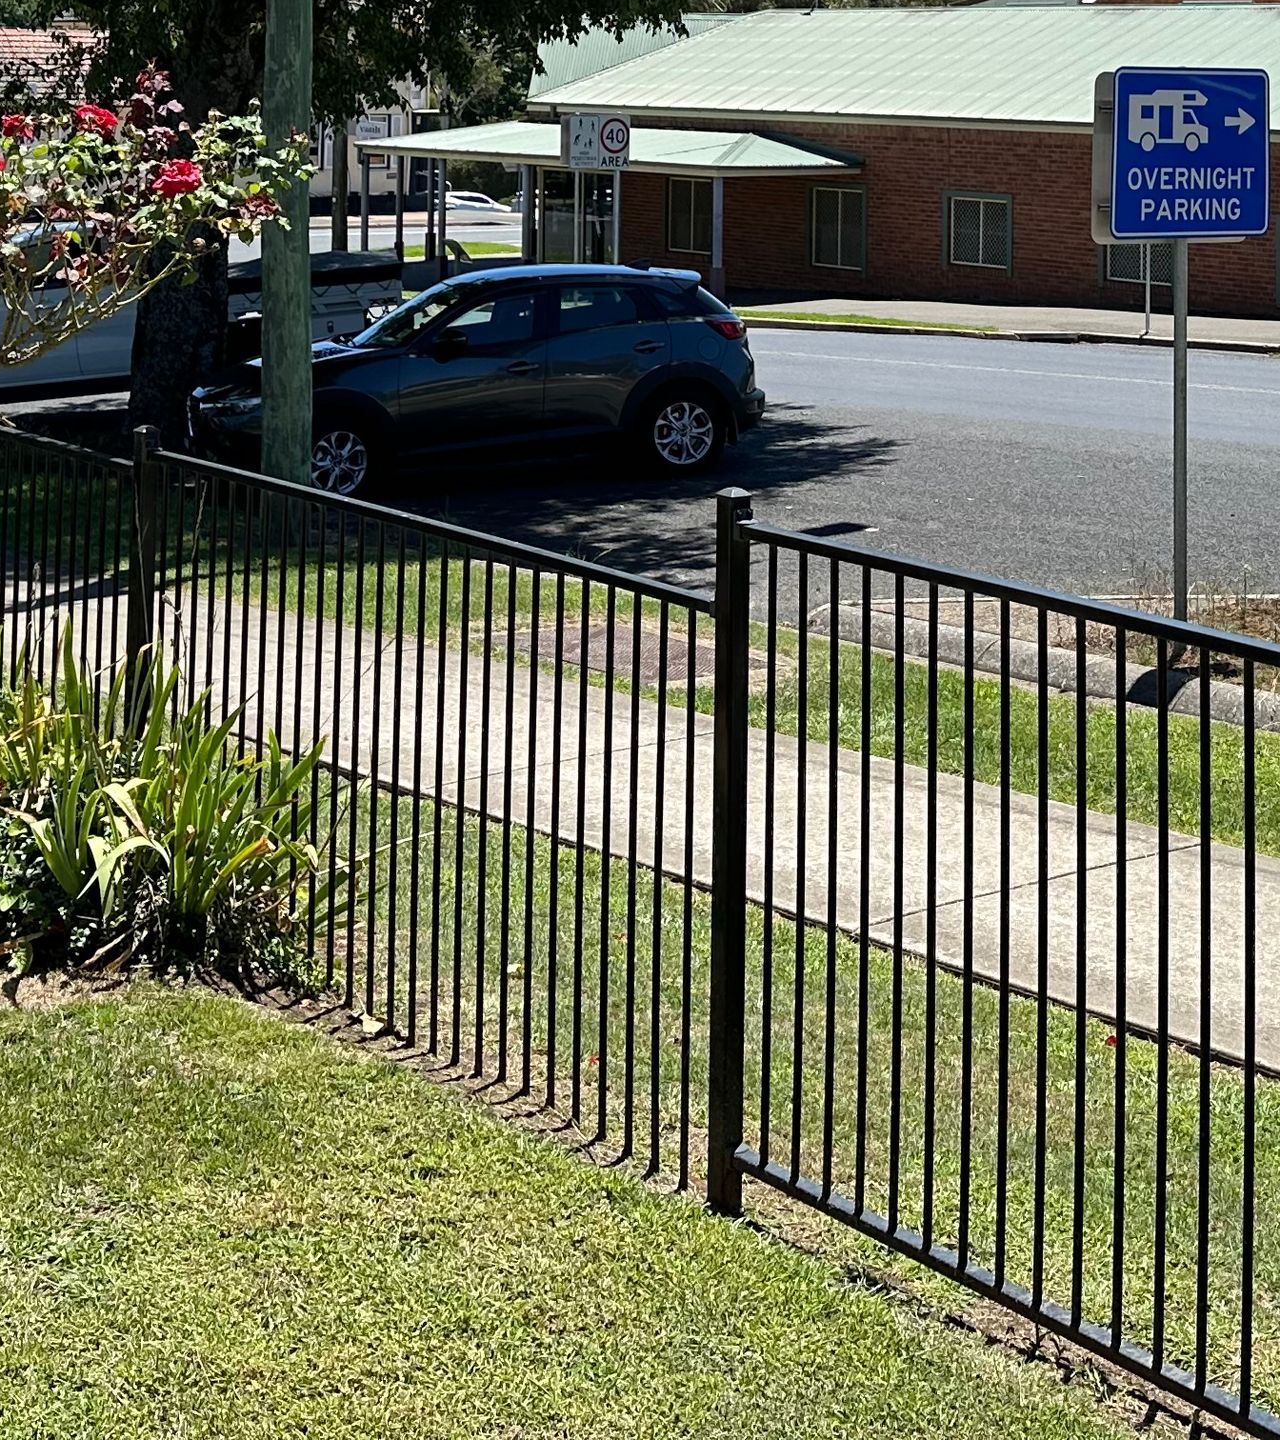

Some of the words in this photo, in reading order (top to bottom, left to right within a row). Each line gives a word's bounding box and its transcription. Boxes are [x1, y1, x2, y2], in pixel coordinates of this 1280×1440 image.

[605, 128, 626, 144] 40
[600, 156, 629, 167] AREA
[1127, 167, 1255, 191] OVERNIGHT
[1140, 197, 1241, 222] PARKING
